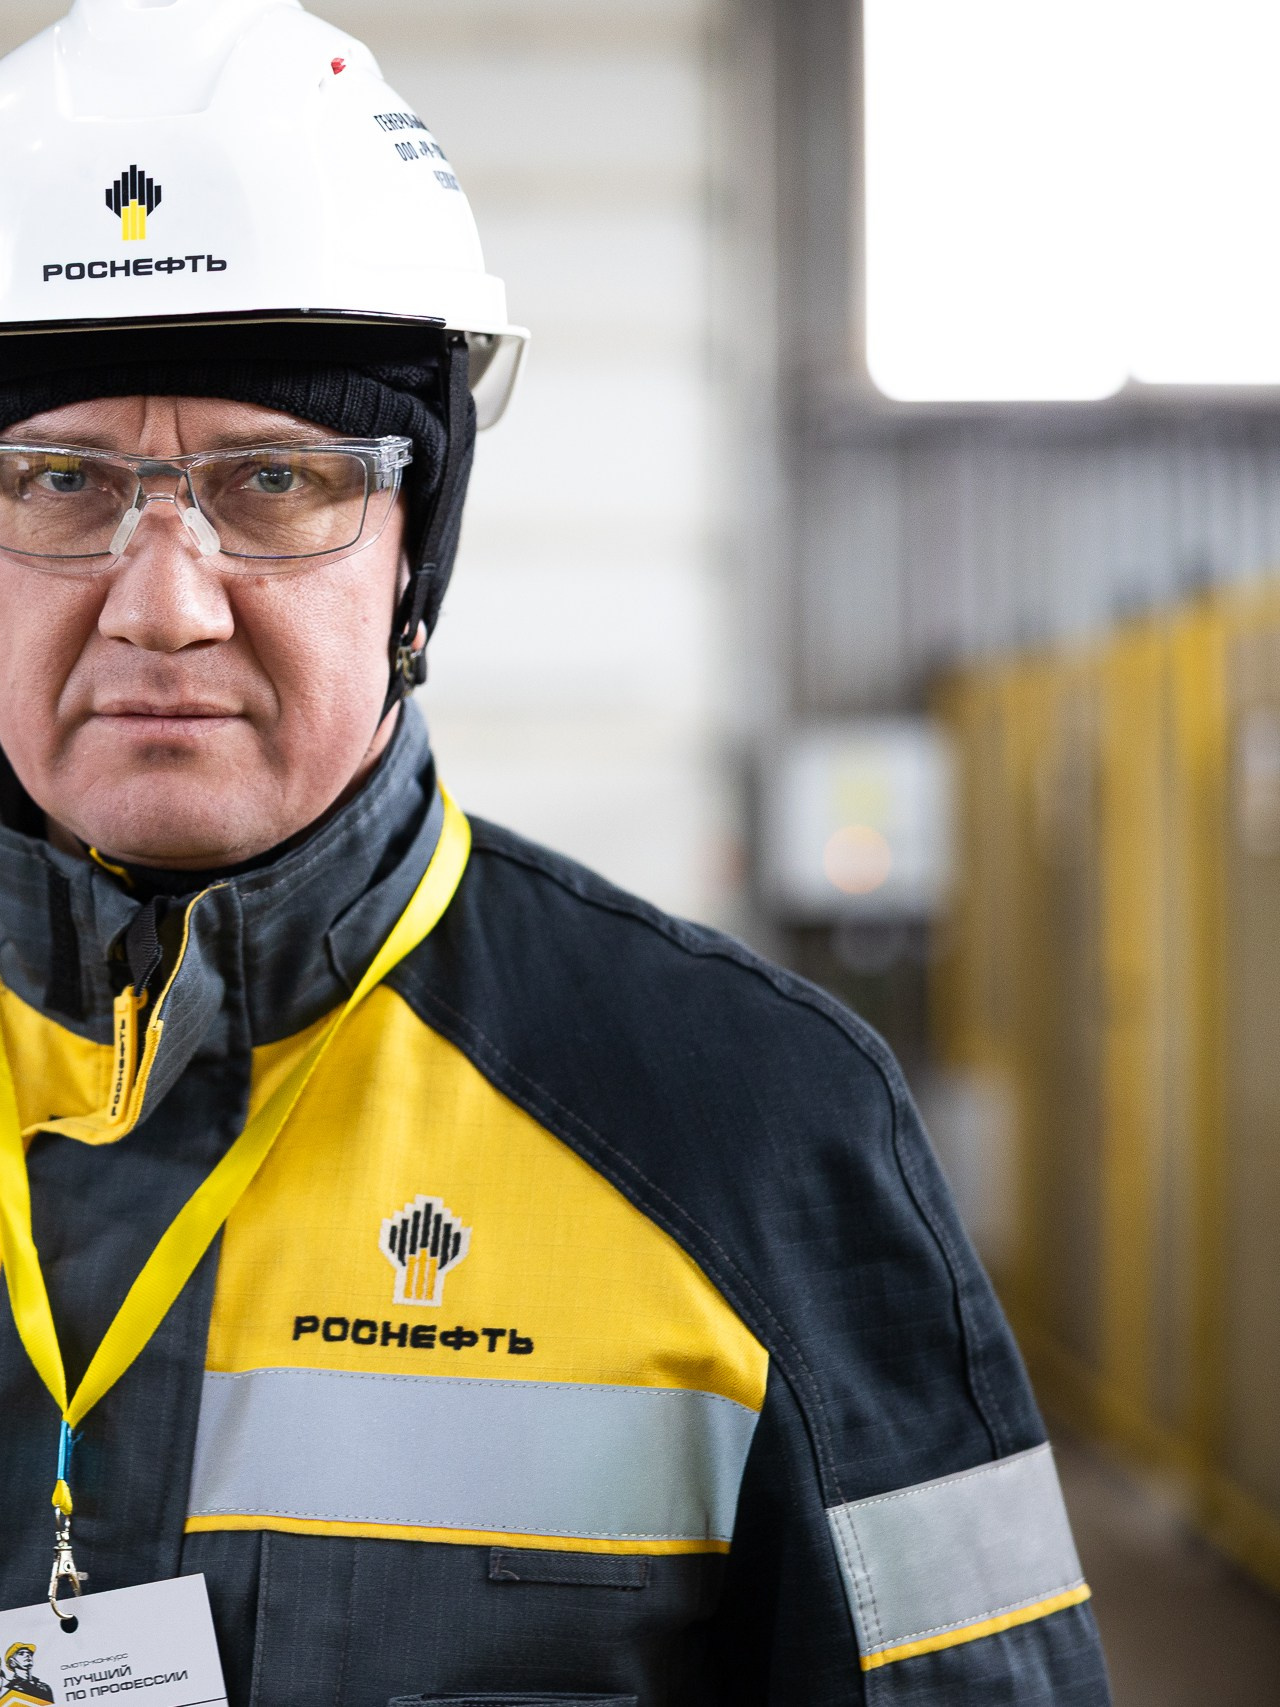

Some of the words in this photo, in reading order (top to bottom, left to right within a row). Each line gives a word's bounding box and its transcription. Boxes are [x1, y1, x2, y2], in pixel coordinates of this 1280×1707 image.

[394, 141, 419, 161] ООО
[43, 254, 227, 282] РОСНЕФТЬ
[111, 1018, 126, 1117] РОСНЕФТЬ
[292, 1315, 535, 1355] РОСНЕФТЬ
[63, 1664, 132, 1688] ЛУЧШИЙ
[65, 1689, 87, 1702] ПО
[90, 1670, 189, 1697] ПРОФЕССИИ
